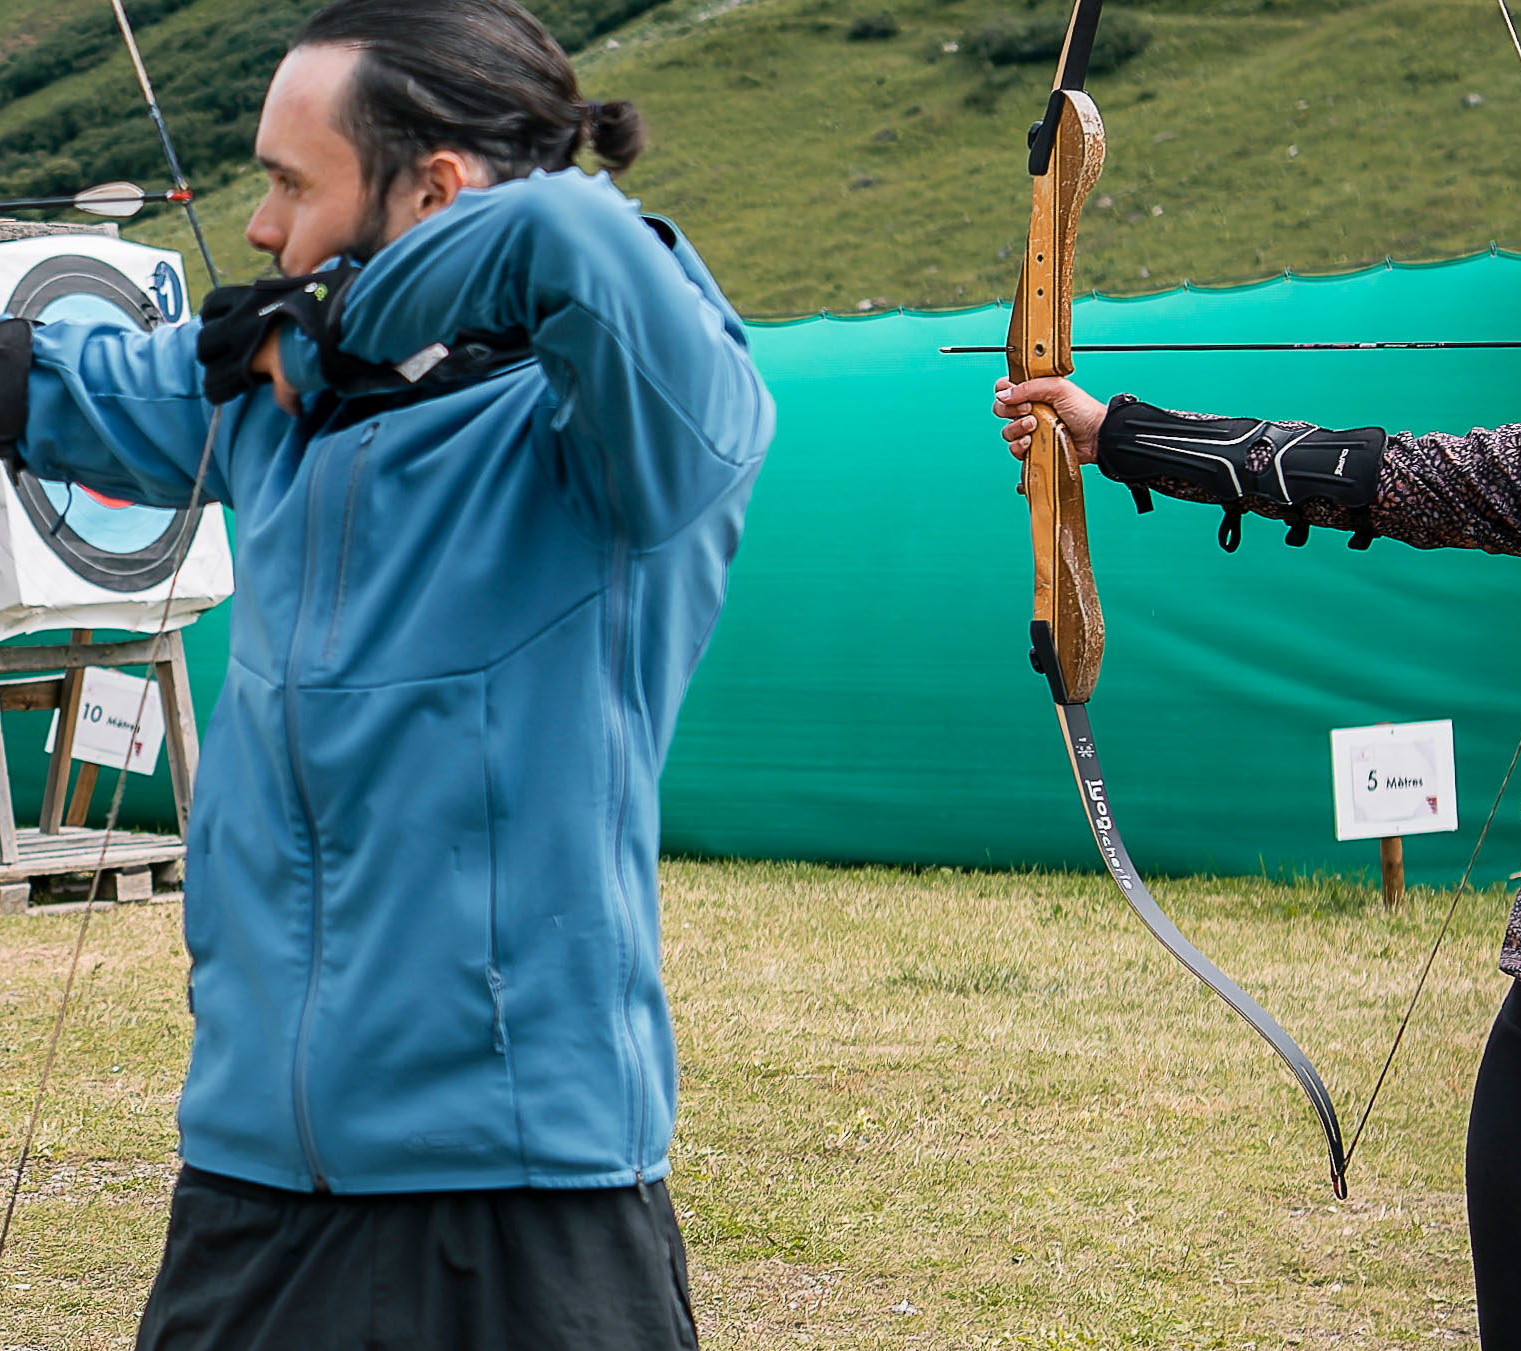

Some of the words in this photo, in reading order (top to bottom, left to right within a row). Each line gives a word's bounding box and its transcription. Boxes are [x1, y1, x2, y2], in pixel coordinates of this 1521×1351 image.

[159, 275, 176, 317] 1
[82, 702, 104, 724] 10
[1367, 769, 1379, 793] 5
[1385, 775, 1424, 791] Mètres
